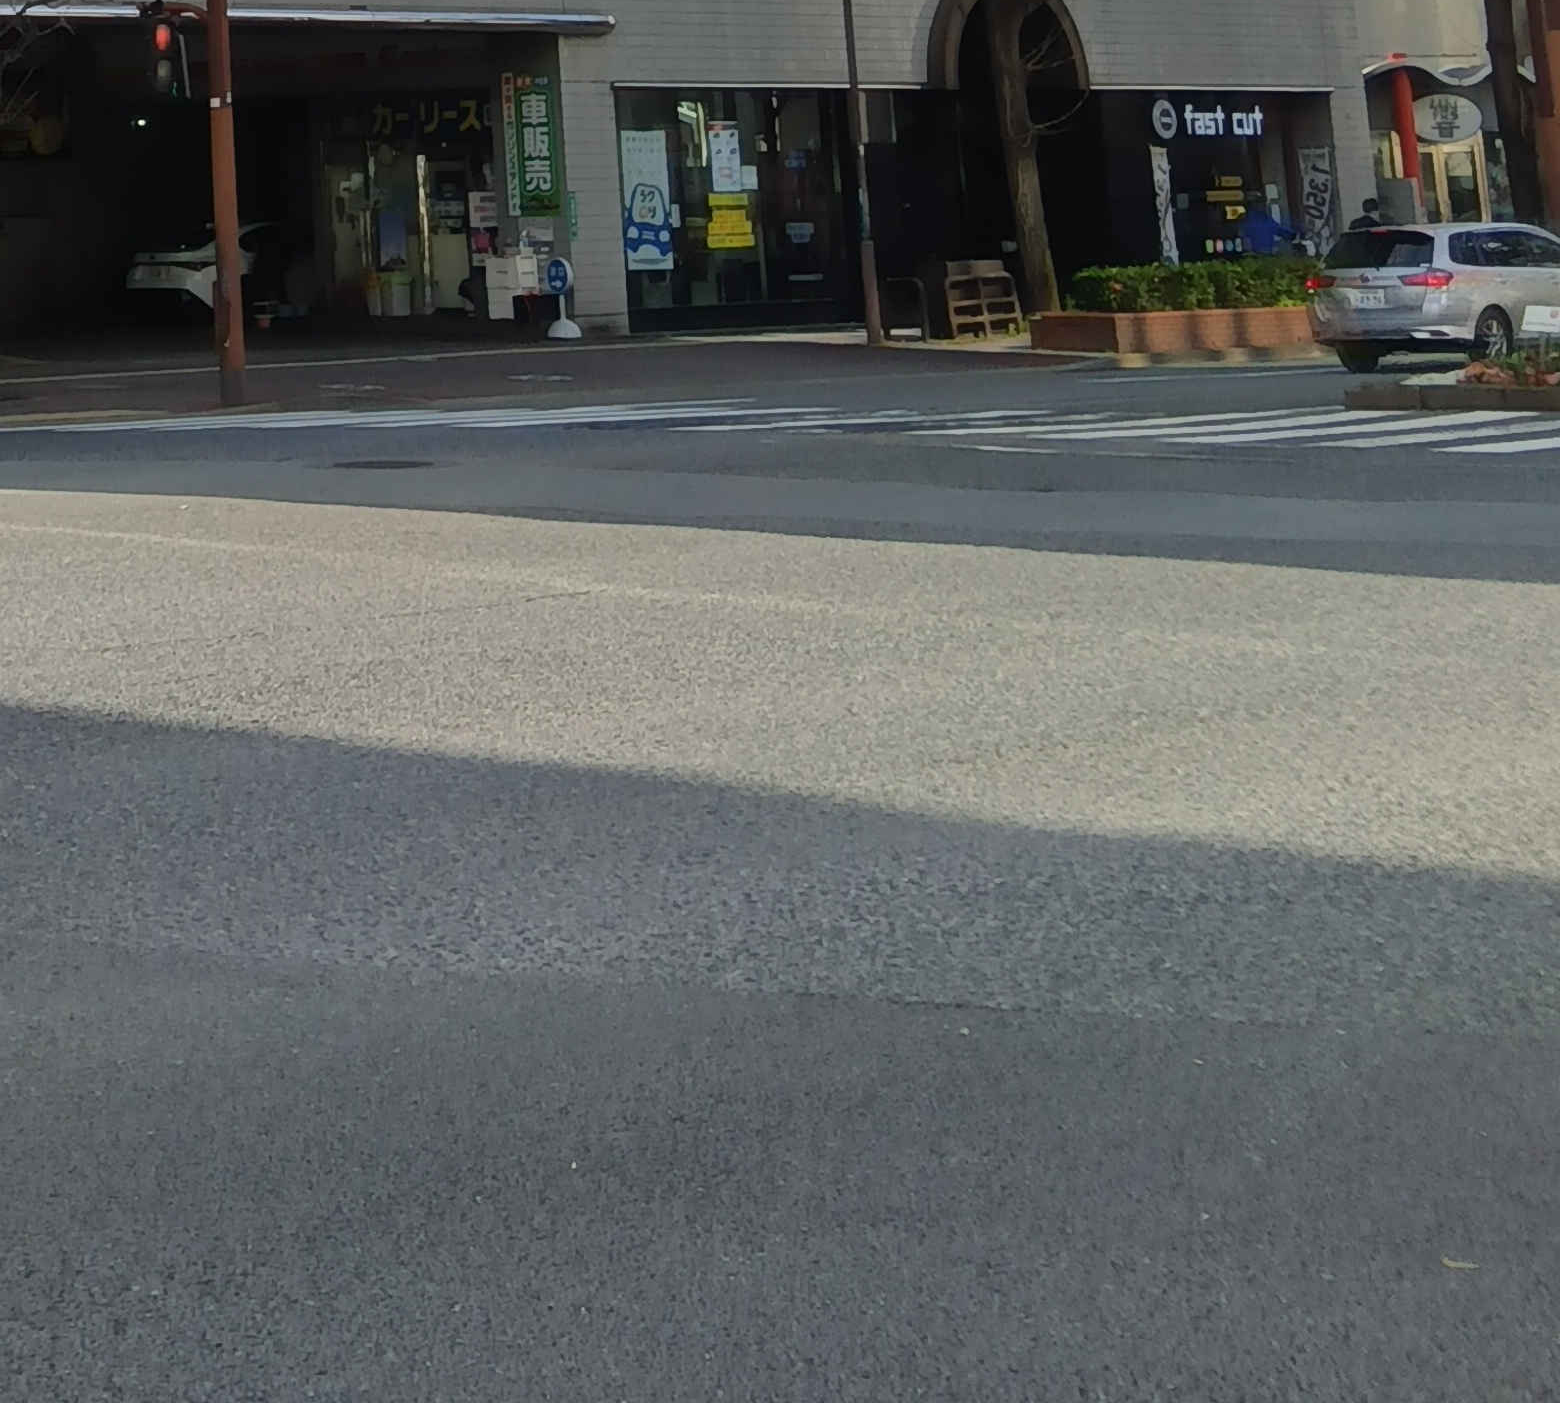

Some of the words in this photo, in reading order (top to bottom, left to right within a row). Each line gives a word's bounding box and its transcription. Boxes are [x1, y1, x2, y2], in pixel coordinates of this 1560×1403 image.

[371, 98, 482, 136] カーリース
[1183, 103, 1226, 135] fast
[1231, 104, 1264, 136] cut
[520, 93, 552, 191] 車販売
